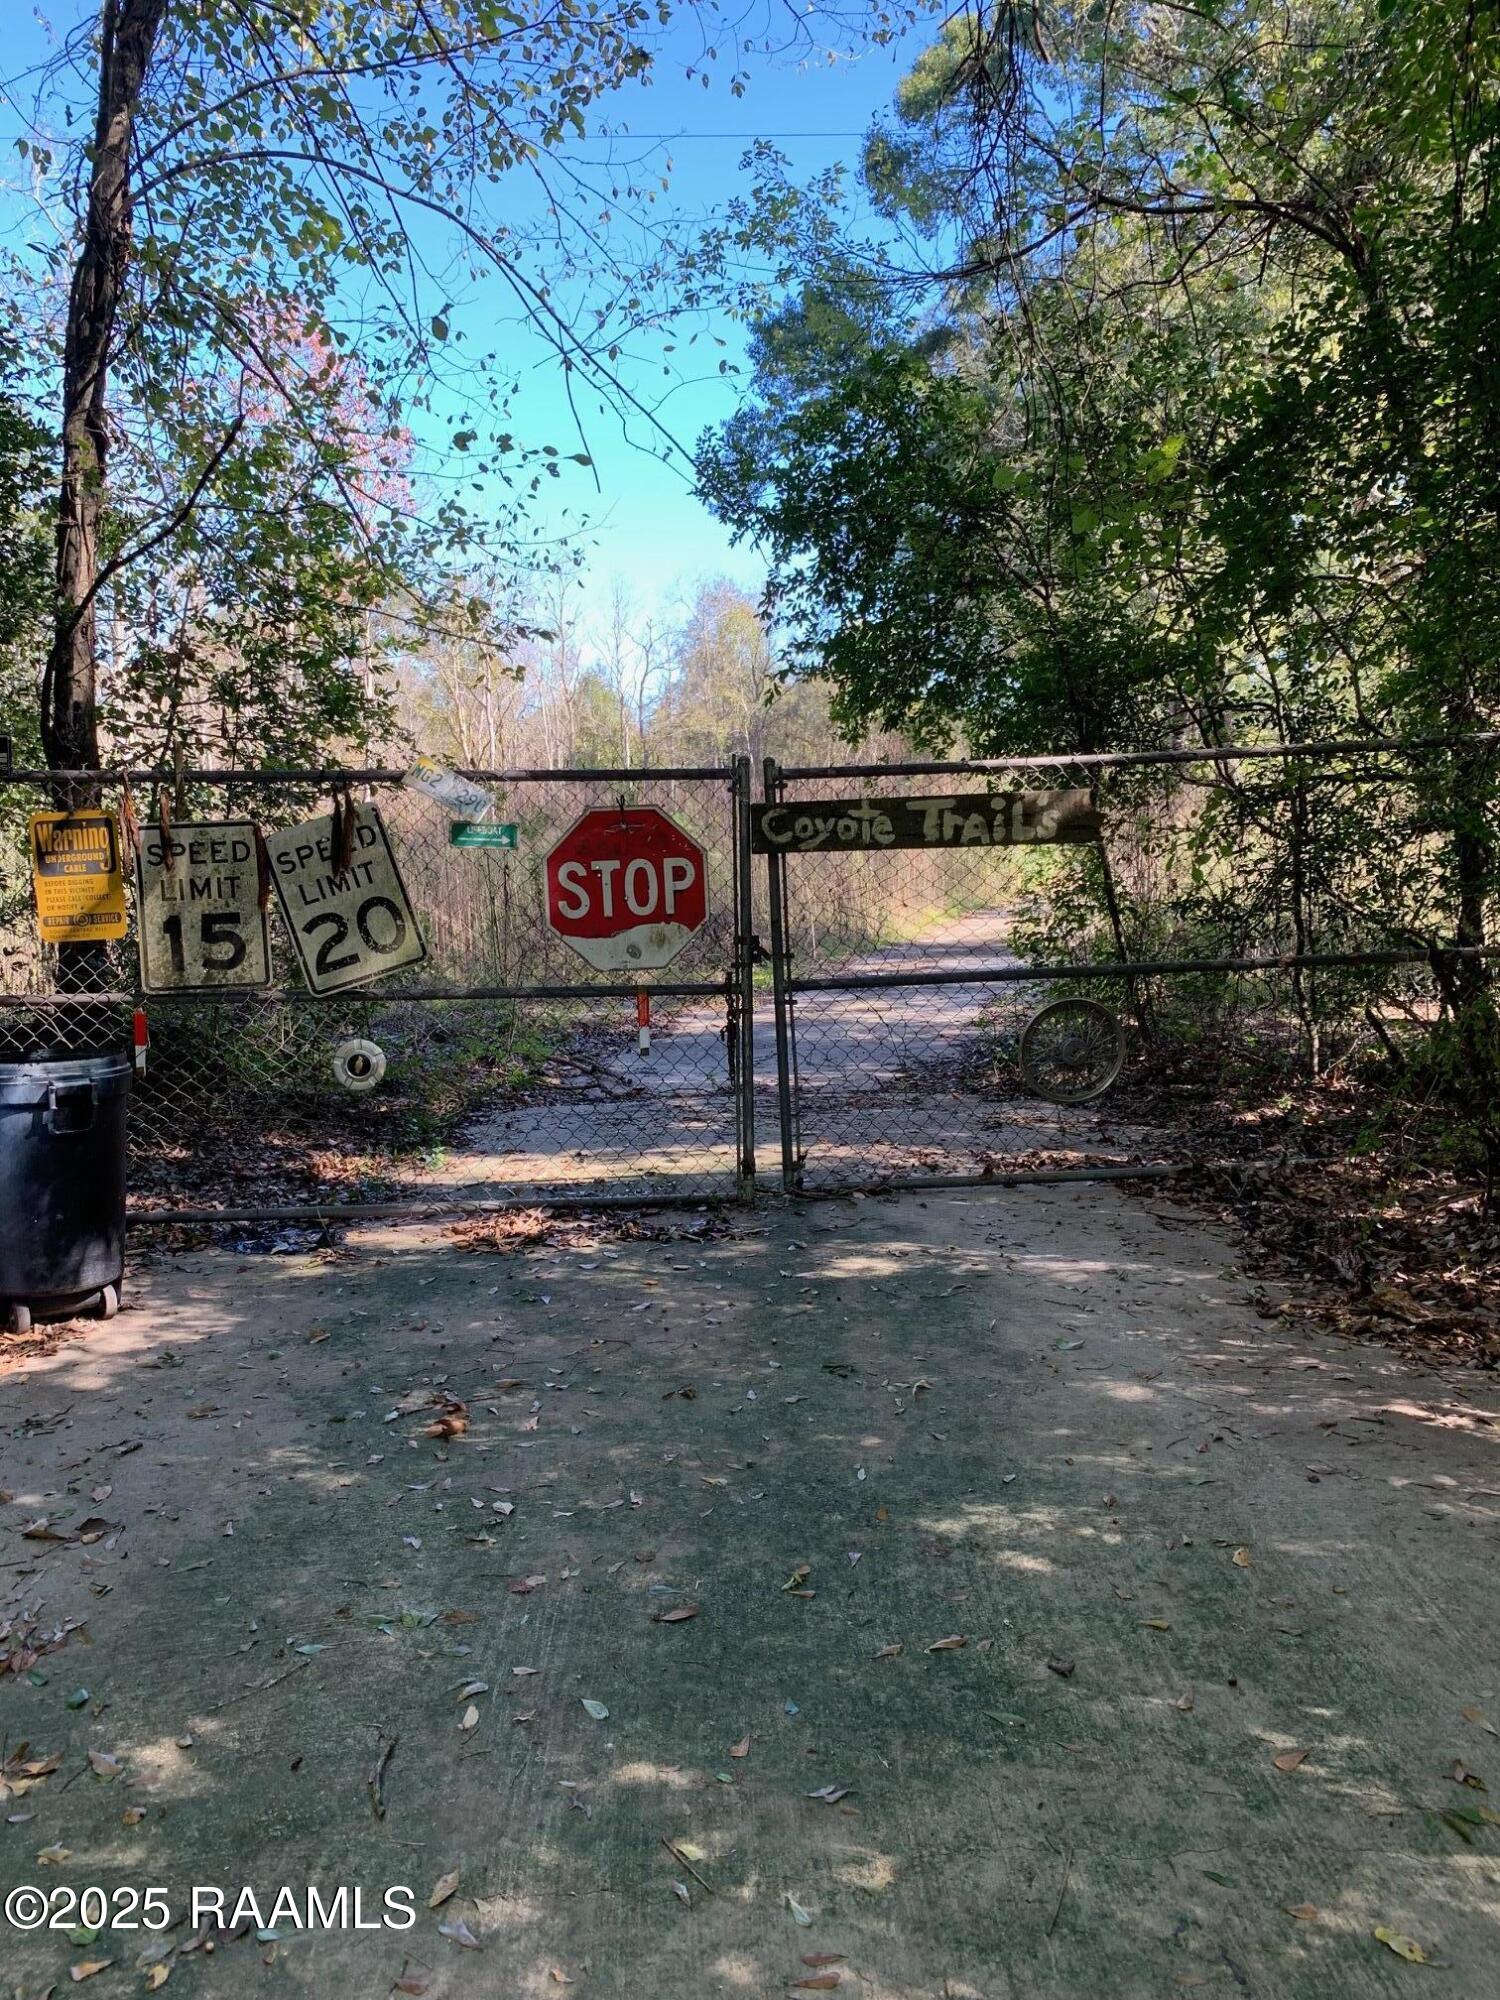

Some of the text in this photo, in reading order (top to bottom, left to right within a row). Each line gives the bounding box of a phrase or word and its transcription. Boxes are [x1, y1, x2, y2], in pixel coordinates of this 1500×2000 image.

[36, 821, 111, 870] Warning
[761, 800, 896, 850] Coyote
[45, 852, 104, 863] UNDERGROUND
[63, 864, 87, 873] CABLE
[146, 840, 250, 867] SPEED
[276, 825, 377, 875] SPED
[160, 876, 241, 901] LIMIT
[298, 861, 374, 906] LIMIT
[558, 857, 696, 920] STOP
[93, 912, 119, 923] SERVICE
[302, 896, 406, 976] 20
[163, 912, 247, 972] 15
